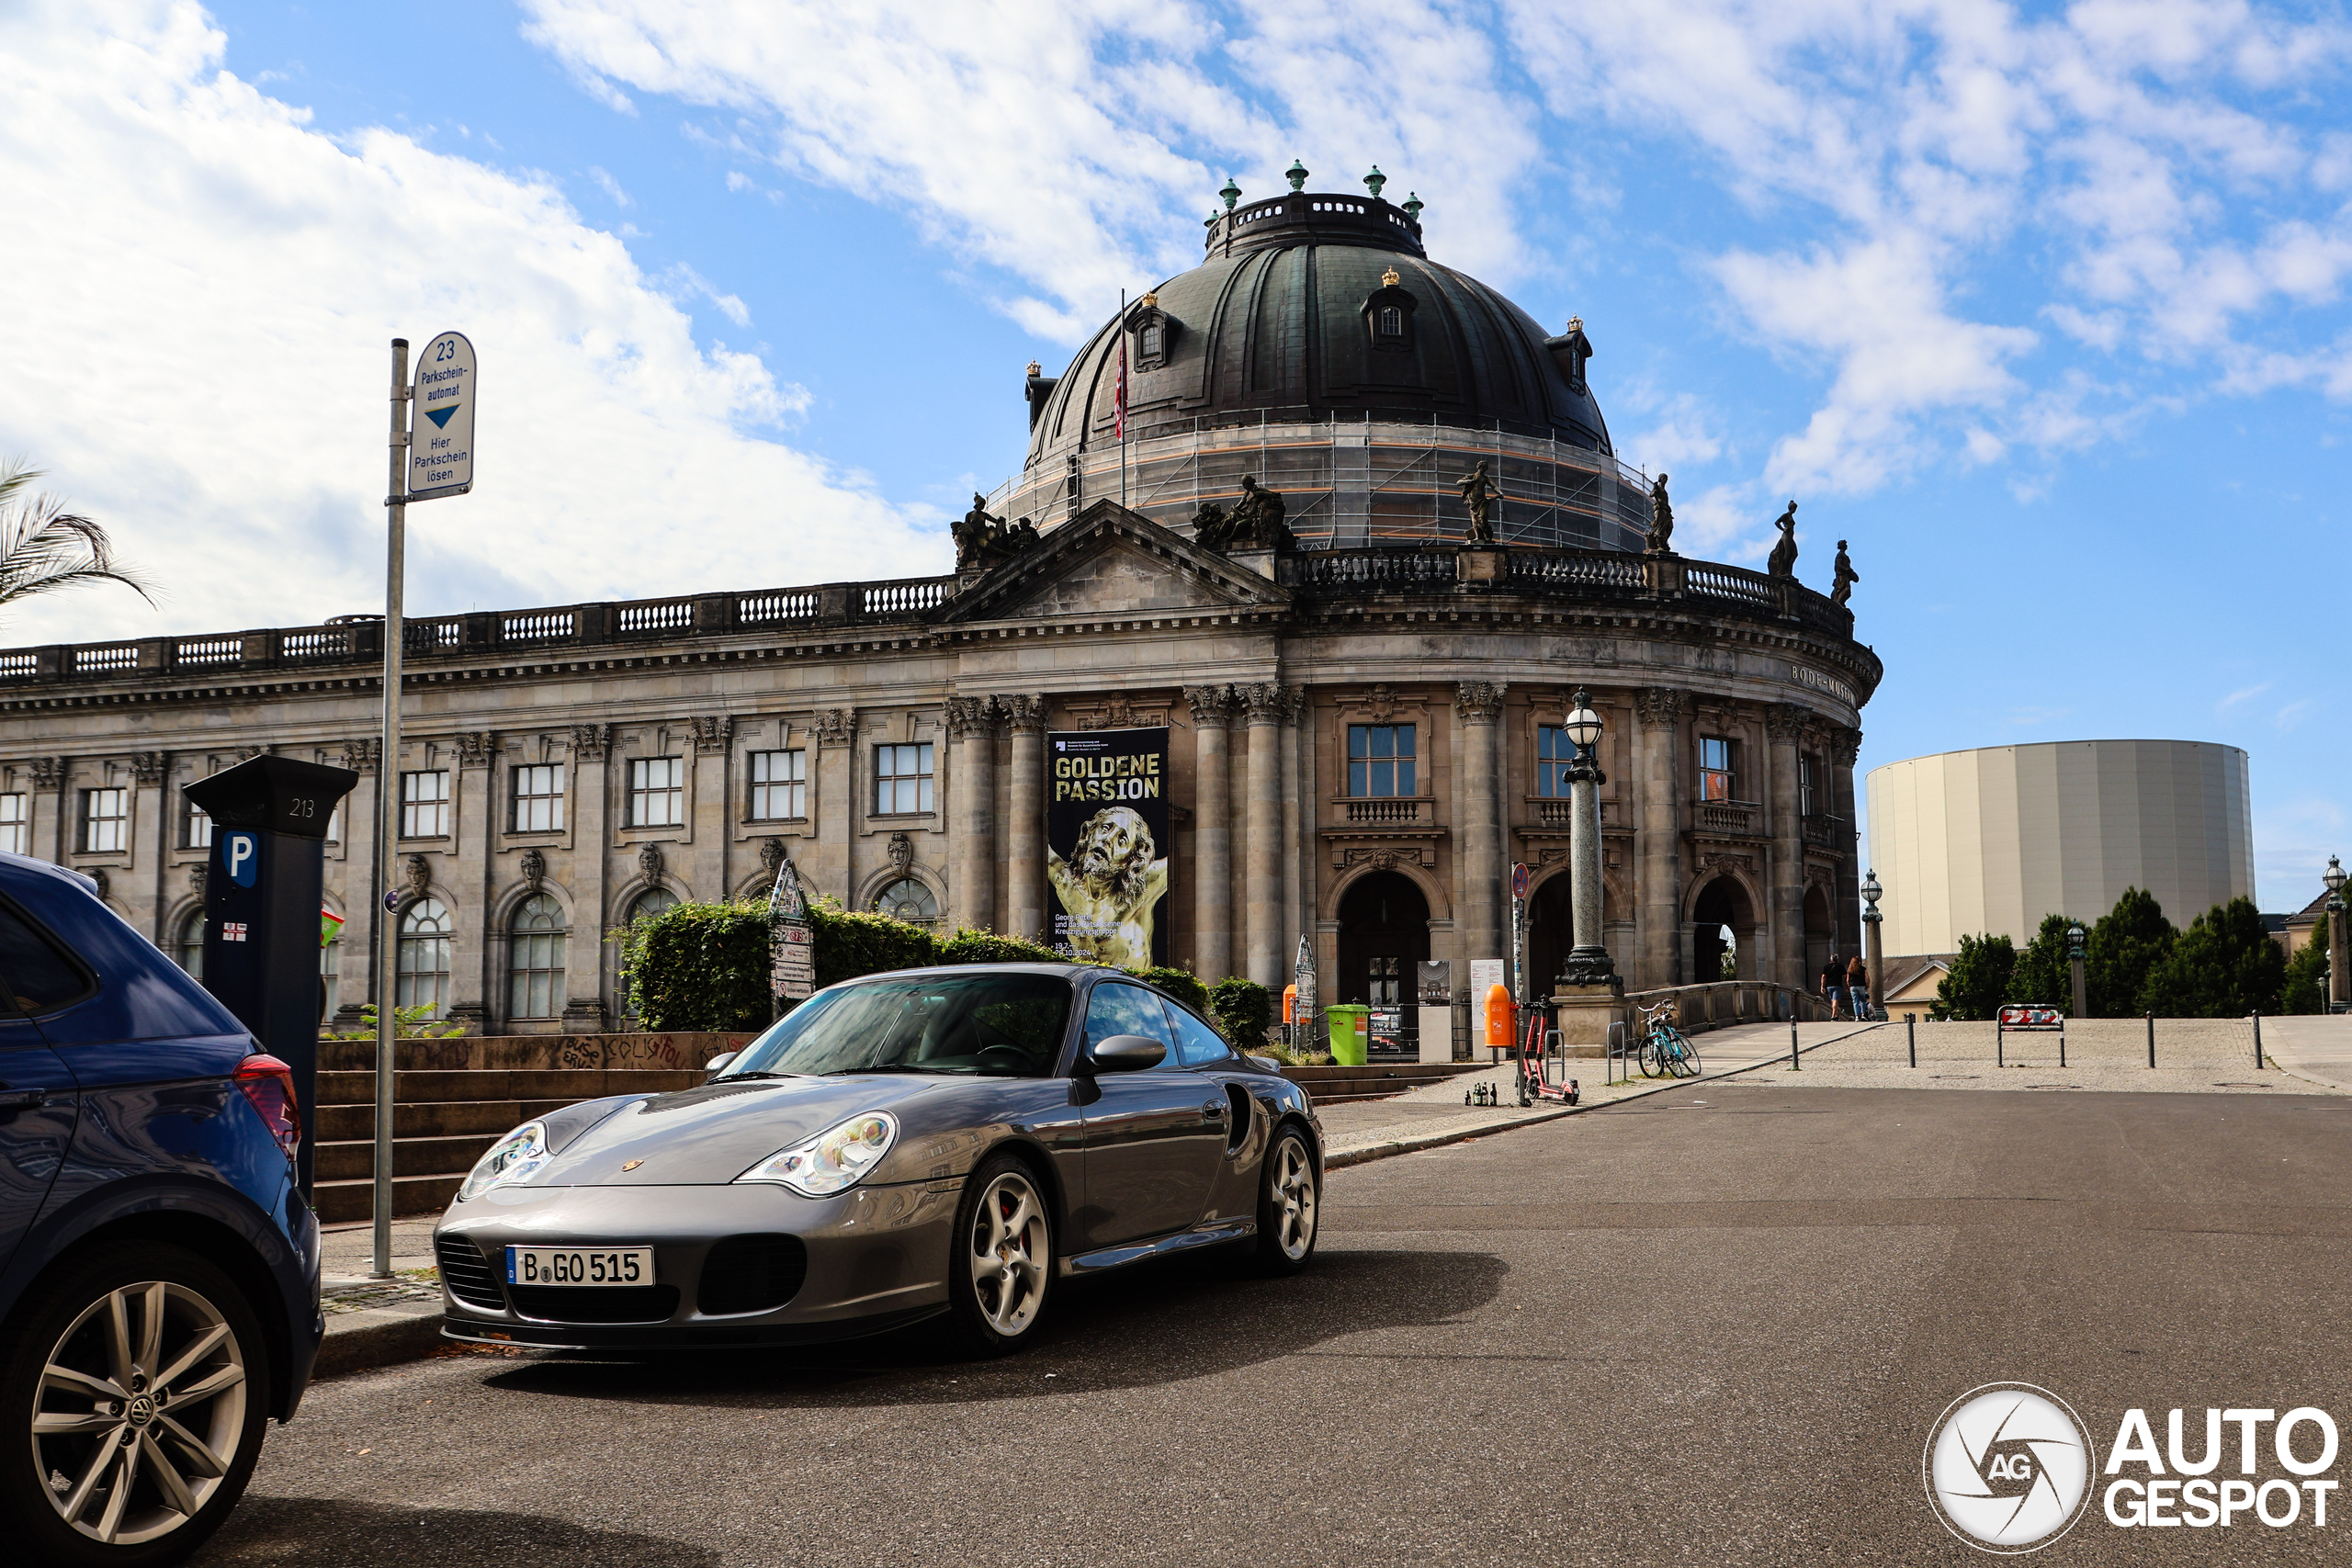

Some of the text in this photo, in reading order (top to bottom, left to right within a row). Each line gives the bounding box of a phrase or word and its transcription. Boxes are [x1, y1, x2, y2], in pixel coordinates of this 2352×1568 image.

[435, 339, 456, 363] 23
[421, 365, 469, 386] Parkschein-
[427, 384, 460, 401] automat
[430, 437, 451, 450] Hier
[414, 450, 468, 469] Parkschein
[426, 469, 454, 483] lösen
[1056, 753, 1159, 778] GOLDENE
[1056, 776, 1159, 802] PASSION
[288, 797, 315, 818] 213
[231, 836, 253, 877] P
[1055, 913, 1074, 921] Georg
[1055, 928, 1117, 936] Kreuzigungsgruppe
[524, 1253, 640, 1282] B GO 515
